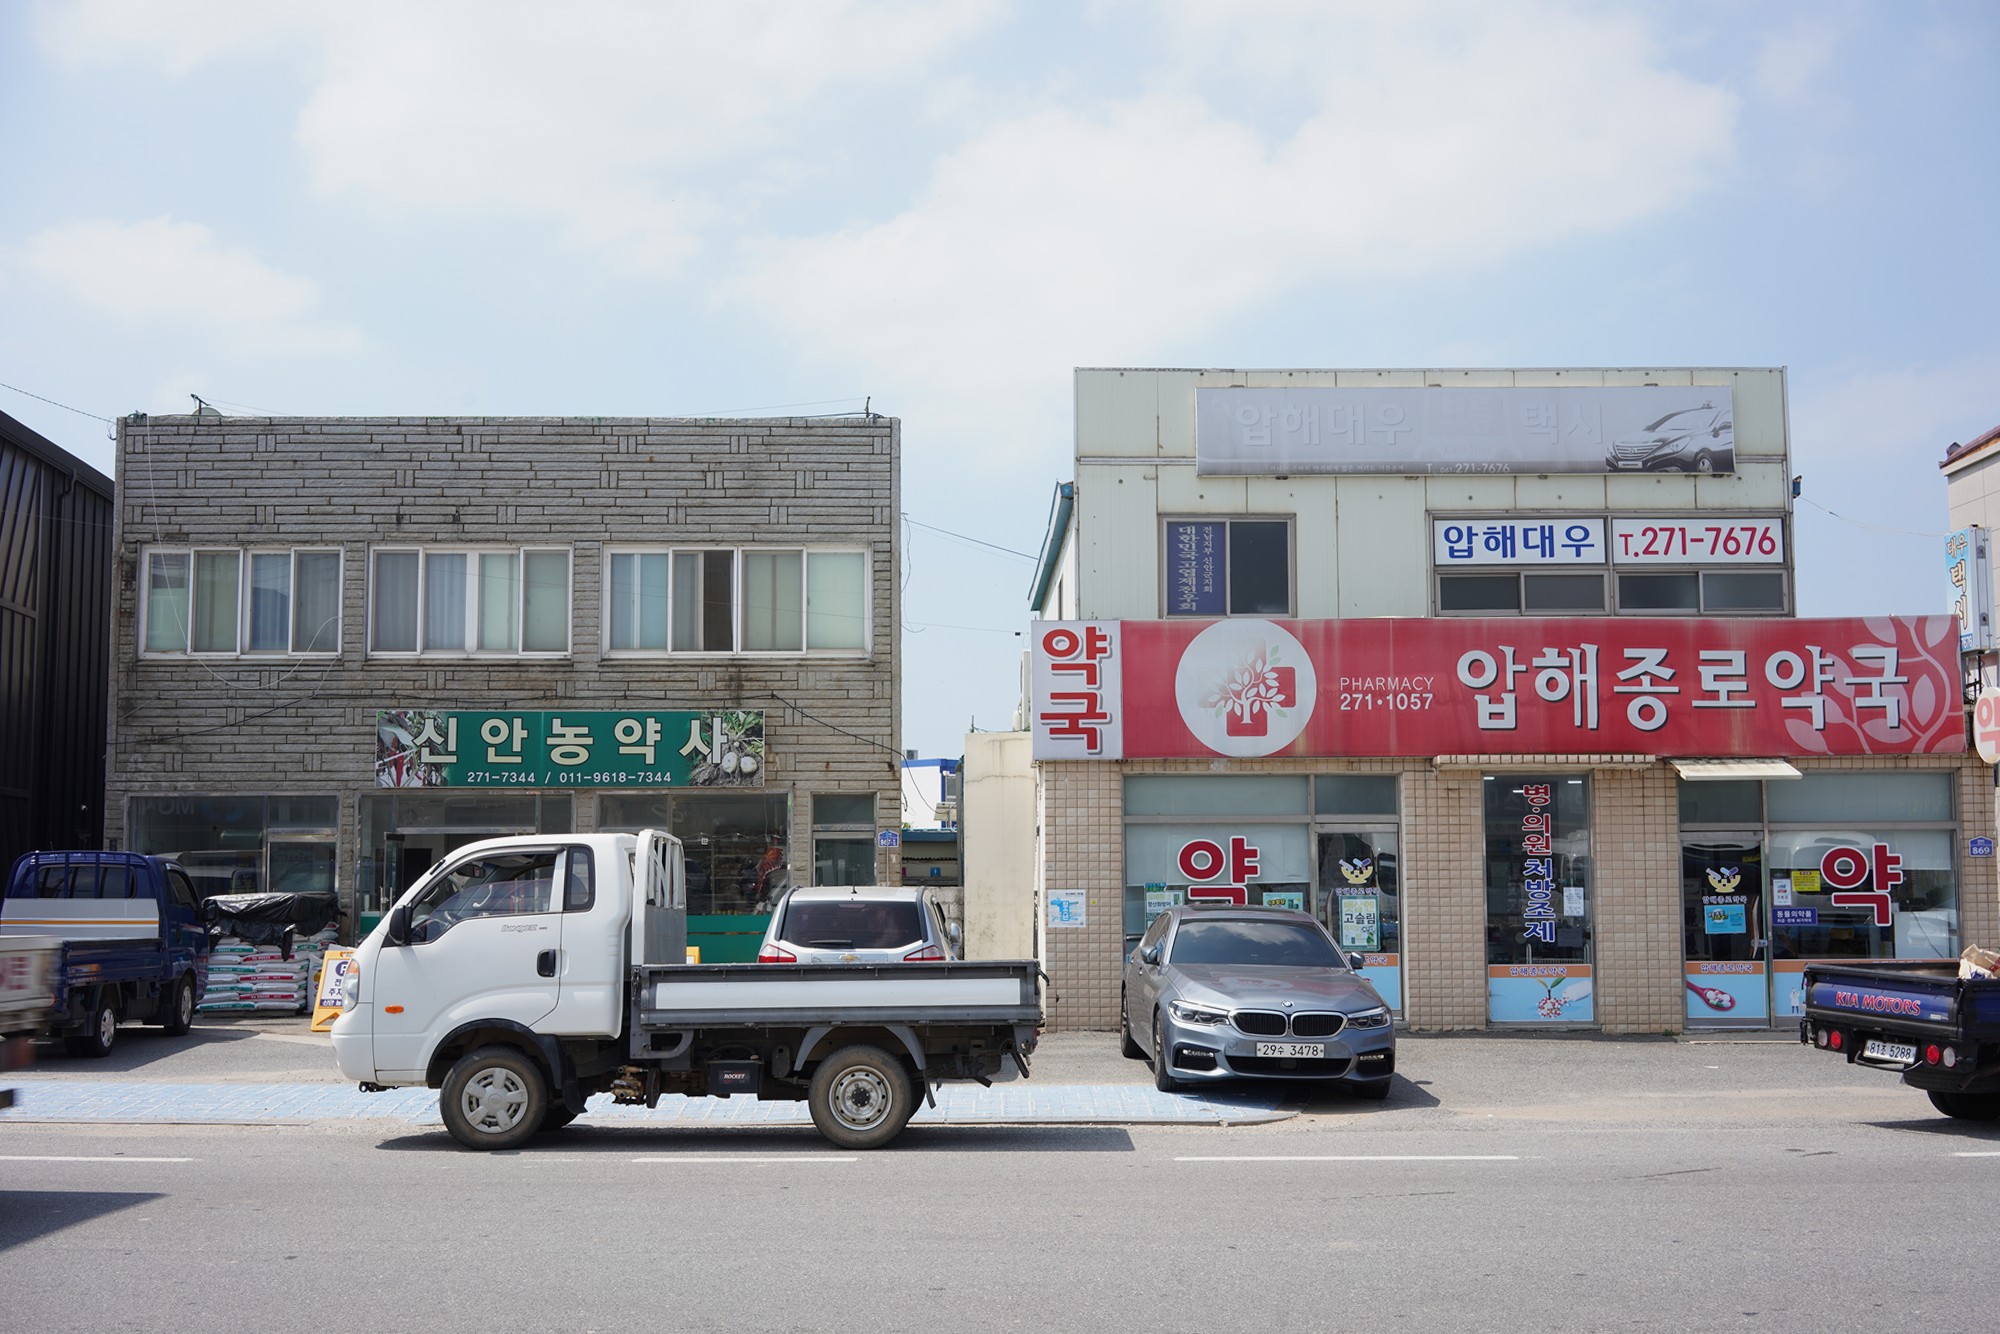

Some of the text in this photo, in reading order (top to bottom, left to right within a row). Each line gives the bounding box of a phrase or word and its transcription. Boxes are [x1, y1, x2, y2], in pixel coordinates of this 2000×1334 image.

[1234, 402, 1413, 447] 압해대우
[1520, 400, 1604, 446] 택시
[1443, 525, 1595, 559] 압해대우
[1619, 526, 1777, 557] T.271-7676
[1946, 534, 1970, 559] 대우
[1039, 625, 1112, 755] 약국
[1339, 677, 1435, 691] PHARMACY
[1456, 643, 1909, 732] 압해종로약국
[1339, 693, 1433, 711] 271·1057
[411, 716, 729, 766] 신안농약사
[466, 771, 536, 784] 271-7344
[559, 771, 672, 784] 011-9618-7344
[1972, 846, 1990, 855] 869
[1178, 835, 1260, 905] 약
[1820, 842, 1903, 927] 약
[1523, 857, 1557, 943] 처방조제
[1343, 912, 1376, 924] 고슬림
[1510, 966, 1567, 977] 압해종로약국
[1701, 963, 1753, 973] 압해종로약국
[1835, 991, 1921, 1017] KIA MOTORS
[1289, 1043, 1320, 1057] 3478
[1889, 1045, 1912, 1060] 5288
